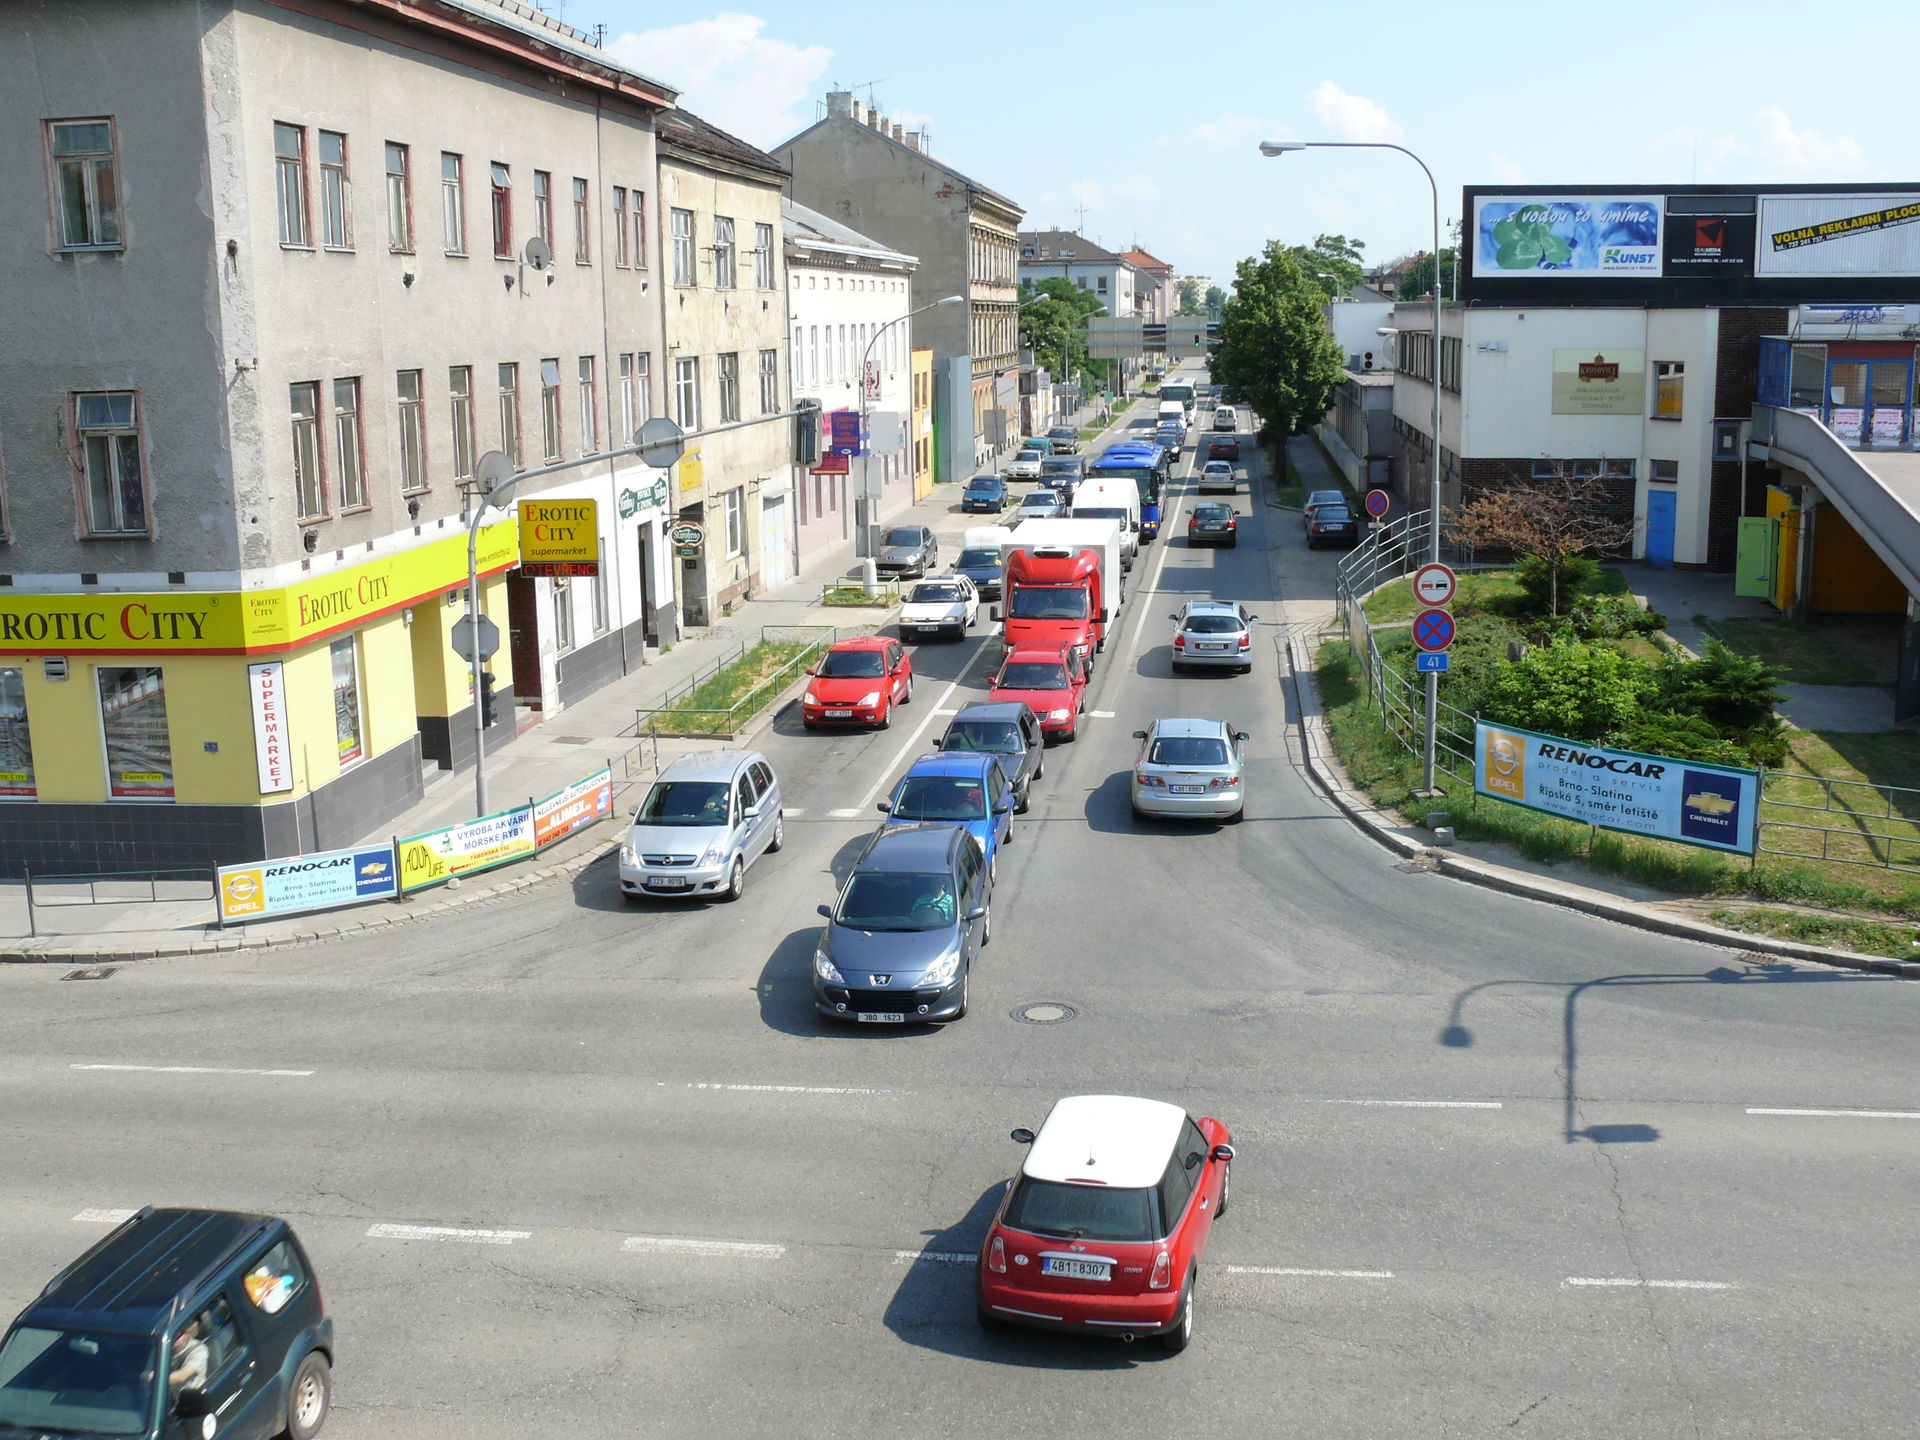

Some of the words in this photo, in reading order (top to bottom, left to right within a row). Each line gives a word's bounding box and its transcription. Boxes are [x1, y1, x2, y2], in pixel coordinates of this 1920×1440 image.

[1506, 210, 1515, 223] s
[1521, 203, 1568, 224] vodou
[1574, 206, 1592, 223] to
[1599, 204, 1649, 224] umíme
[1774, 226, 1816, 244] VOLNÁ
[1819, 211, 1881, 235] REKLAMNÍ
[1885, 203, 1920, 221] PLOC
[1788, 241, 1799, 249] 737
[1800, 238, 1811, 246] 241
[1603, 249, 1656, 264] KUNST
[525, 504, 590, 522] EROTIC
[535, 523, 577, 542] CITY
[531, 547, 587, 557] supermarket
[250, 598, 281, 608] EROTIC
[298, 587, 353, 627] EROTIC
[358, 575, 390, 605] CITY
[254, 608, 273, 617] CITY
[119, 603, 208, 641] CITY
[1427, 656, 1439, 667] 41
[260, 668, 282, 787] SUPERMARKET
[1538, 743, 1665, 780] RENOCAR
[1489, 776, 1520, 794] OPEL
[1538, 761, 1582, 780] prodej
[1593, 774, 1600, 782] a
[1611, 776, 1662, 792] servis
[1558, 777, 1583, 793] Brno
[1591, 785, 1633, 802] Slatina
[1542, 800, 1656, 830] www.renocar.com
[1574, 795, 1585, 807] 5,
[1588, 799, 1617, 813] směr
[1620, 802, 1659, 820] letiště
[1689, 814, 1729, 826] CHEVROLET
[502, 826, 525, 841] RYBY
[265, 857, 352, 878] RENOCAR
[405, 844, 430, 873] AQUA
[428, 861, 444, 878] LIFE
[284, 884, 303, 892] Brno
[309, 879, 337, 888] Slatina
[356, 876, 392, 886] CHEVROLET
[228, 901, 260, 914] OPEL
[1052, 1260, 1071, 1273] 4B1
[1079, 1263, 1105, 1276] 8307
